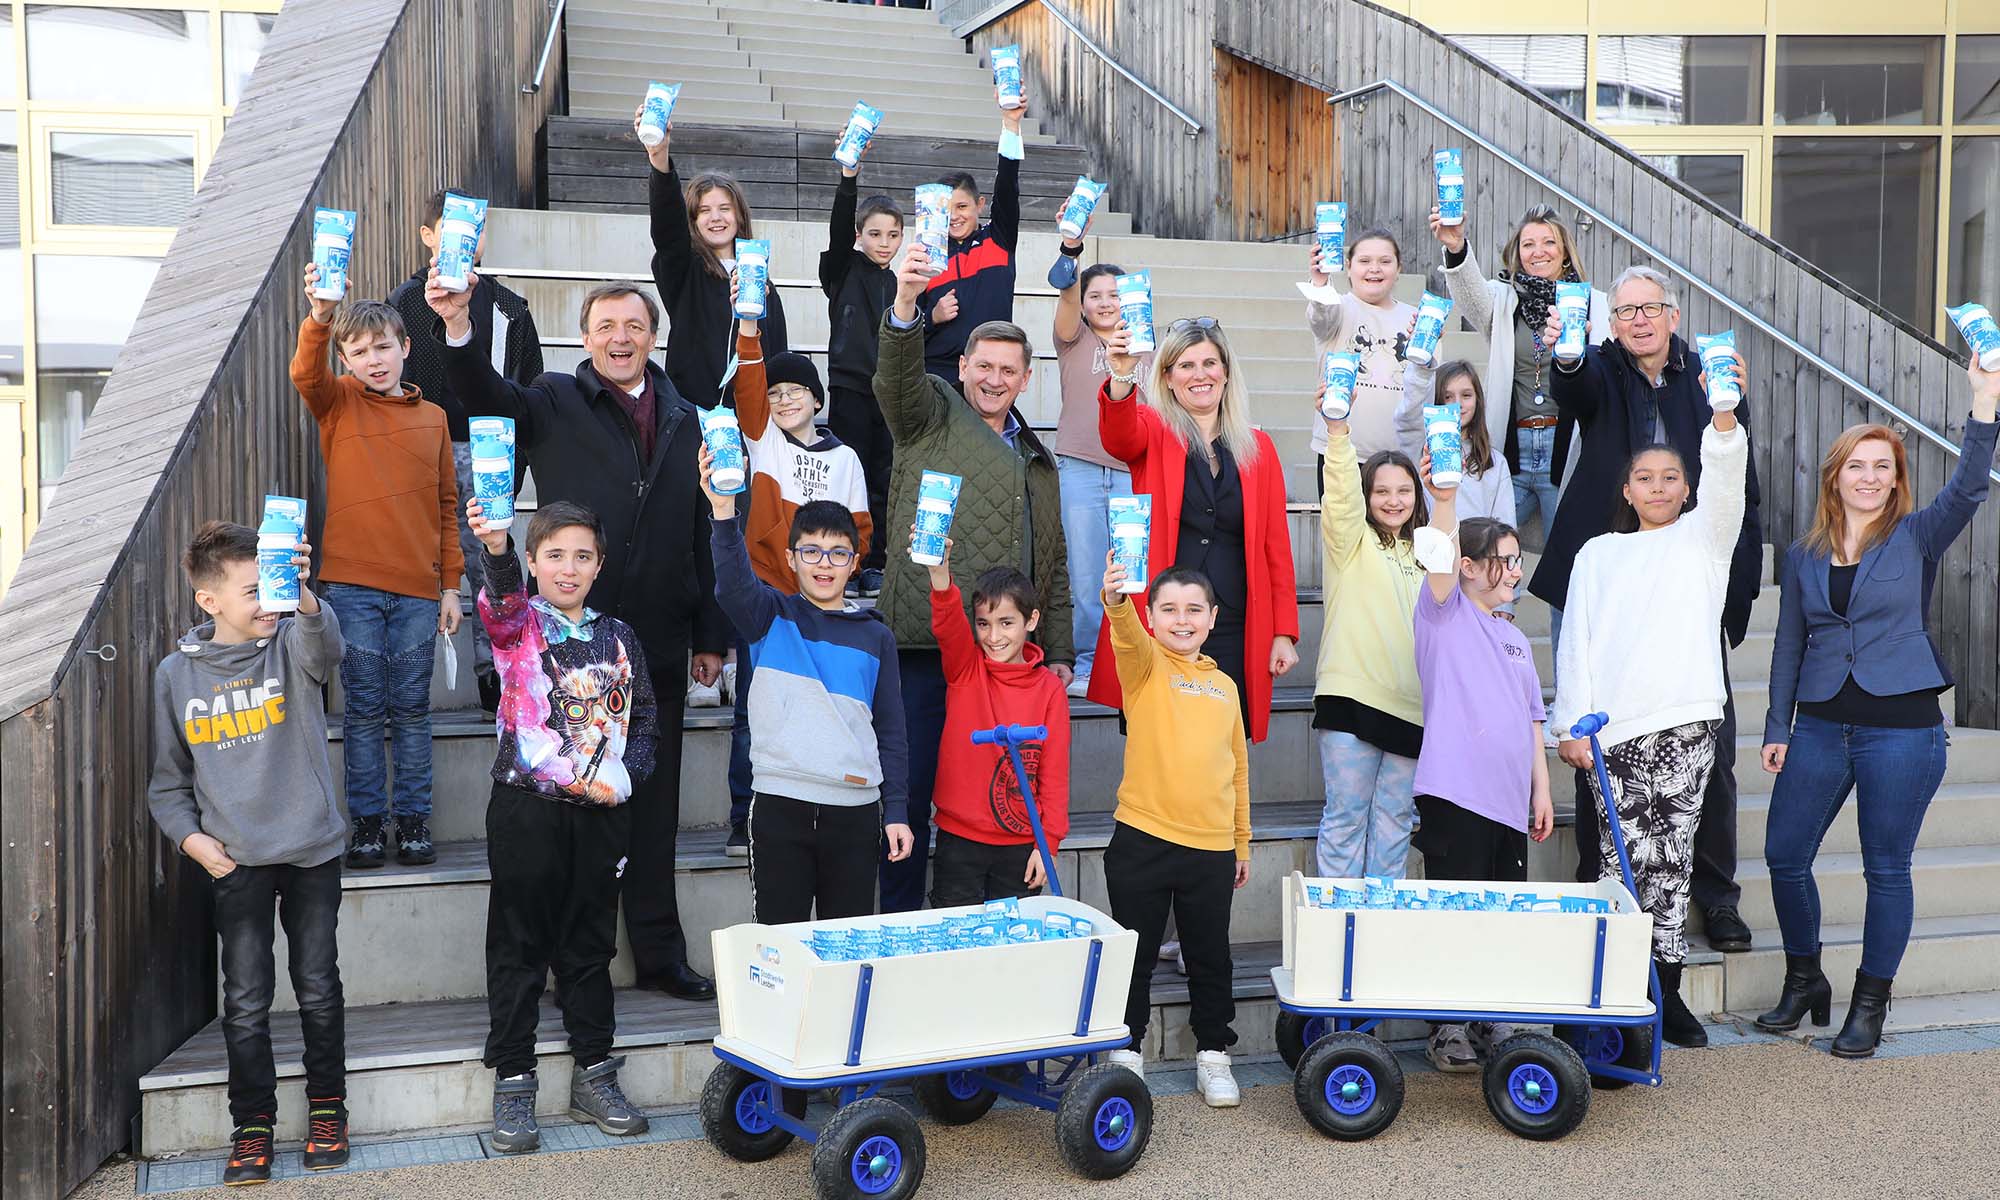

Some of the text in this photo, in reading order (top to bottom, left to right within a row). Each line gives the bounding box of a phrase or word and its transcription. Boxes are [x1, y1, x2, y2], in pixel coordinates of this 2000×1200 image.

[794, 454, 831, 474] OSTON
[185, 678, 287, 745] GAME
[217, 739, 236, 751] NEXT
